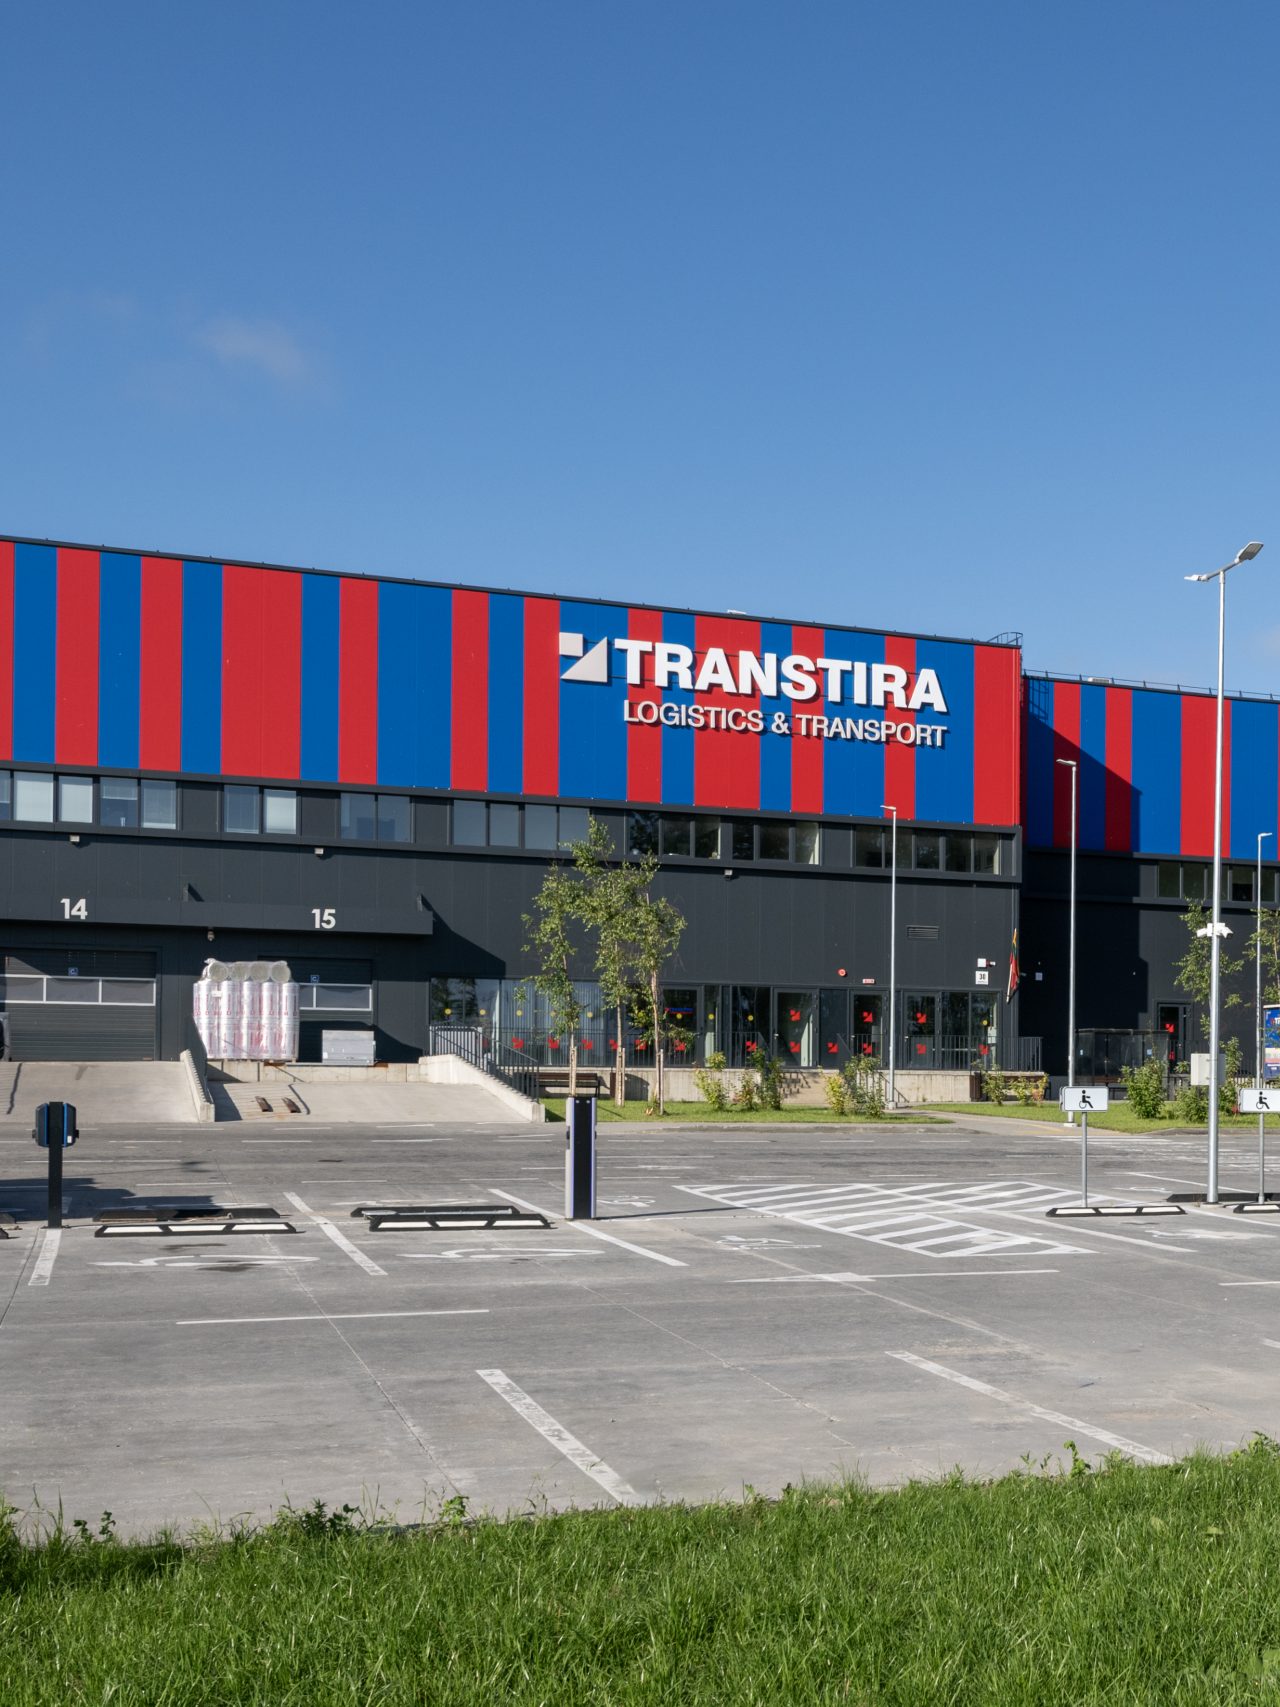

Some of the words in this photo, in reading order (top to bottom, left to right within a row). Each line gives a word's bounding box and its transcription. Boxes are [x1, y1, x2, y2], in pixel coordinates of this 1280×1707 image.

[613, 638, 948, 713] TRANSTIRA
[624, 700, 764, 732] LOGISTICS
[772, 711, 791, 734] &
[796, 713, 948, 747] TRANSPORT
[60, 898, 88, 920] 14
[311, 908, 336, 929] 15
